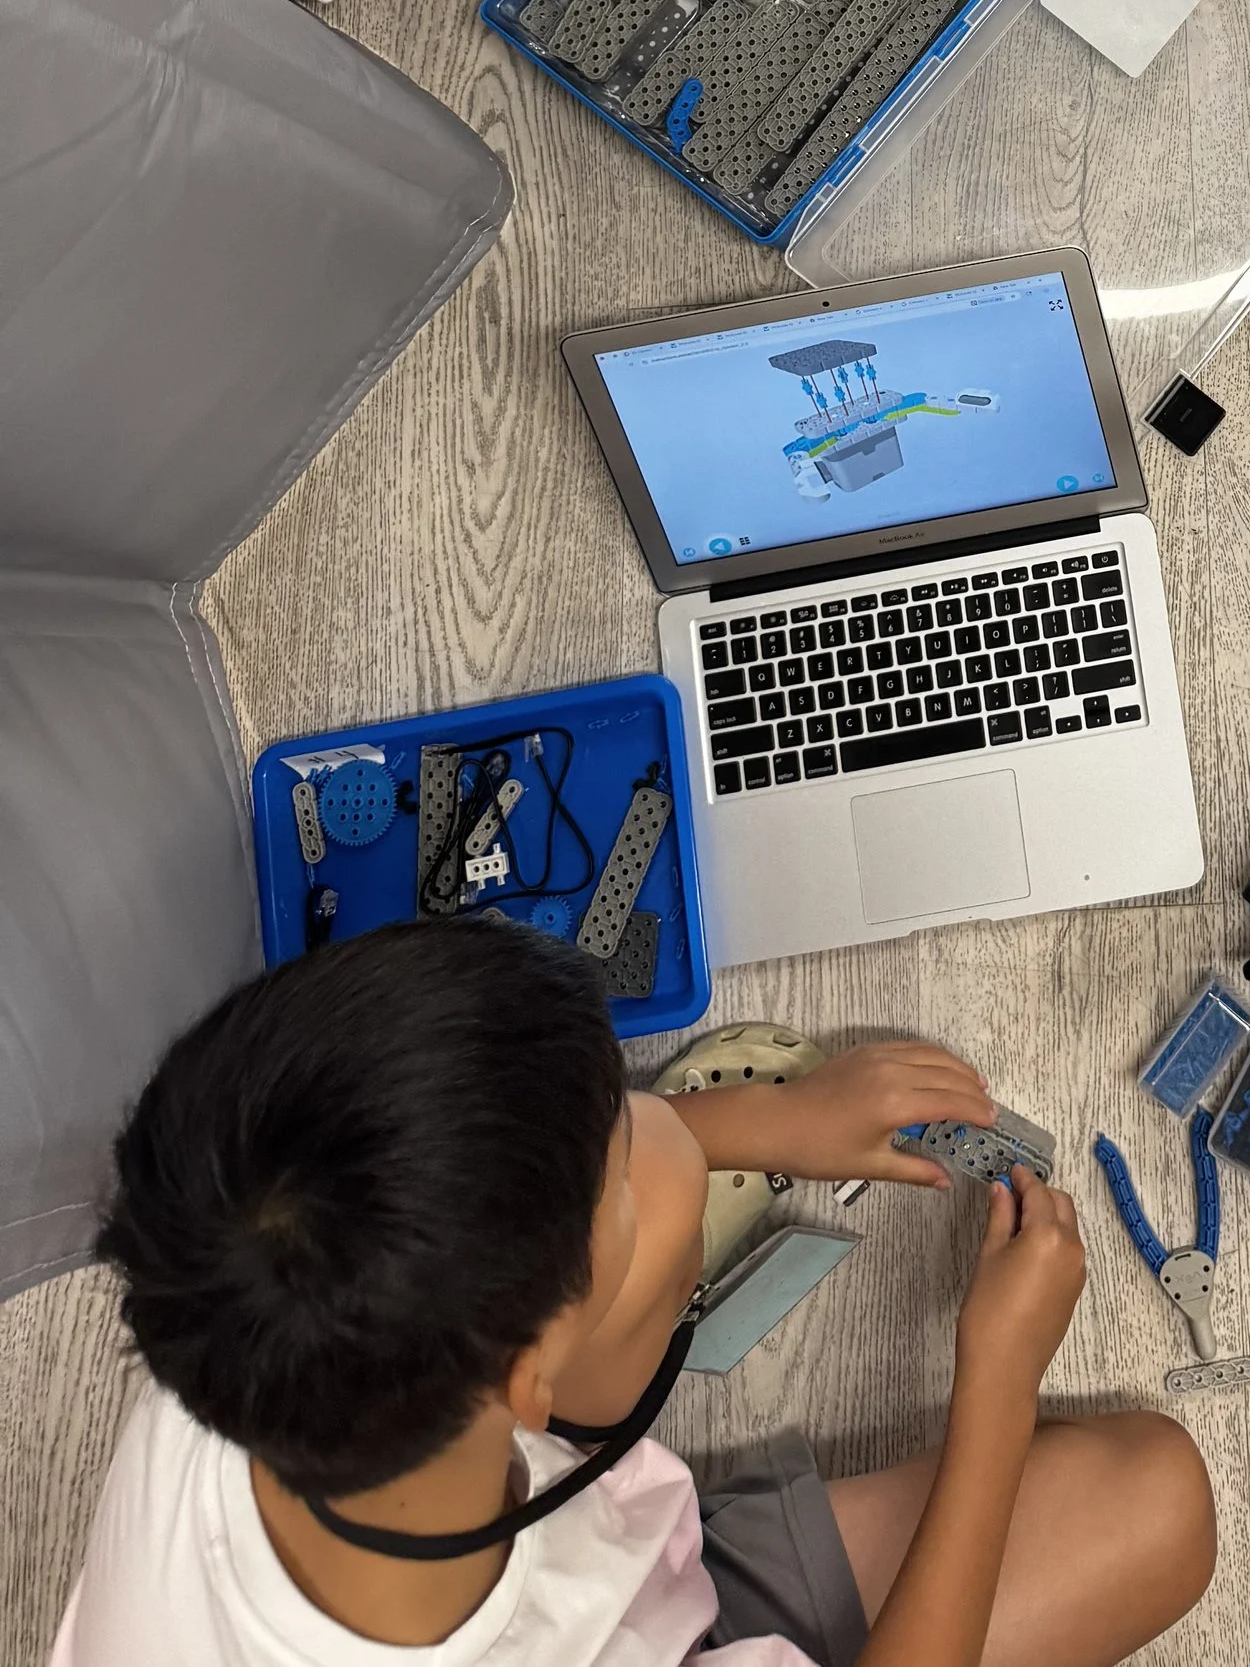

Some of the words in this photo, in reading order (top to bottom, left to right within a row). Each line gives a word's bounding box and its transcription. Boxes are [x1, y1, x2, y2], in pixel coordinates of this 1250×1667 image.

[757, 672, 766, 682] Q
[786, 667, 796, 676] W
[817, 661, 823, 671] E
[847, 656, 853, 666] R
[905, 645, 912, 655] Y
[933, 640, 941, 650] U
[992, 630, 1000, 639] O
[1022, 625, 1029, 634] P
[770, 645, 777, 654] 2
[800, 640, 806, 648] 3
[859, 629, 865, 638] 5
[888, 624, 894, 632] 6
[917, 618, 923, 627] 7
[975, 608, 981, 616] 9
[1004, 602, 1011, 611] 0
[768, 701, 776, 711] A
[798, 696, 805, 705] S
[827, 691, 835, 700] D
[858, 685, 863, 695] F
[886, 679, 894, 689] G
[916, 675, 923, 684] H
[947, 669, 952, 679] J
[974, 664, 982, 673] K
[1004, 659, 1010, 668] L
[787, 729, 794, 739] Z
[816, 723, 824, 733] X
[845, 718, 853, 727] C
[875, 713, 882, 722] V
[905, 707, 912, 717] B
[934, 702, 942, 711] N
[963, 697, 972, 707] M
